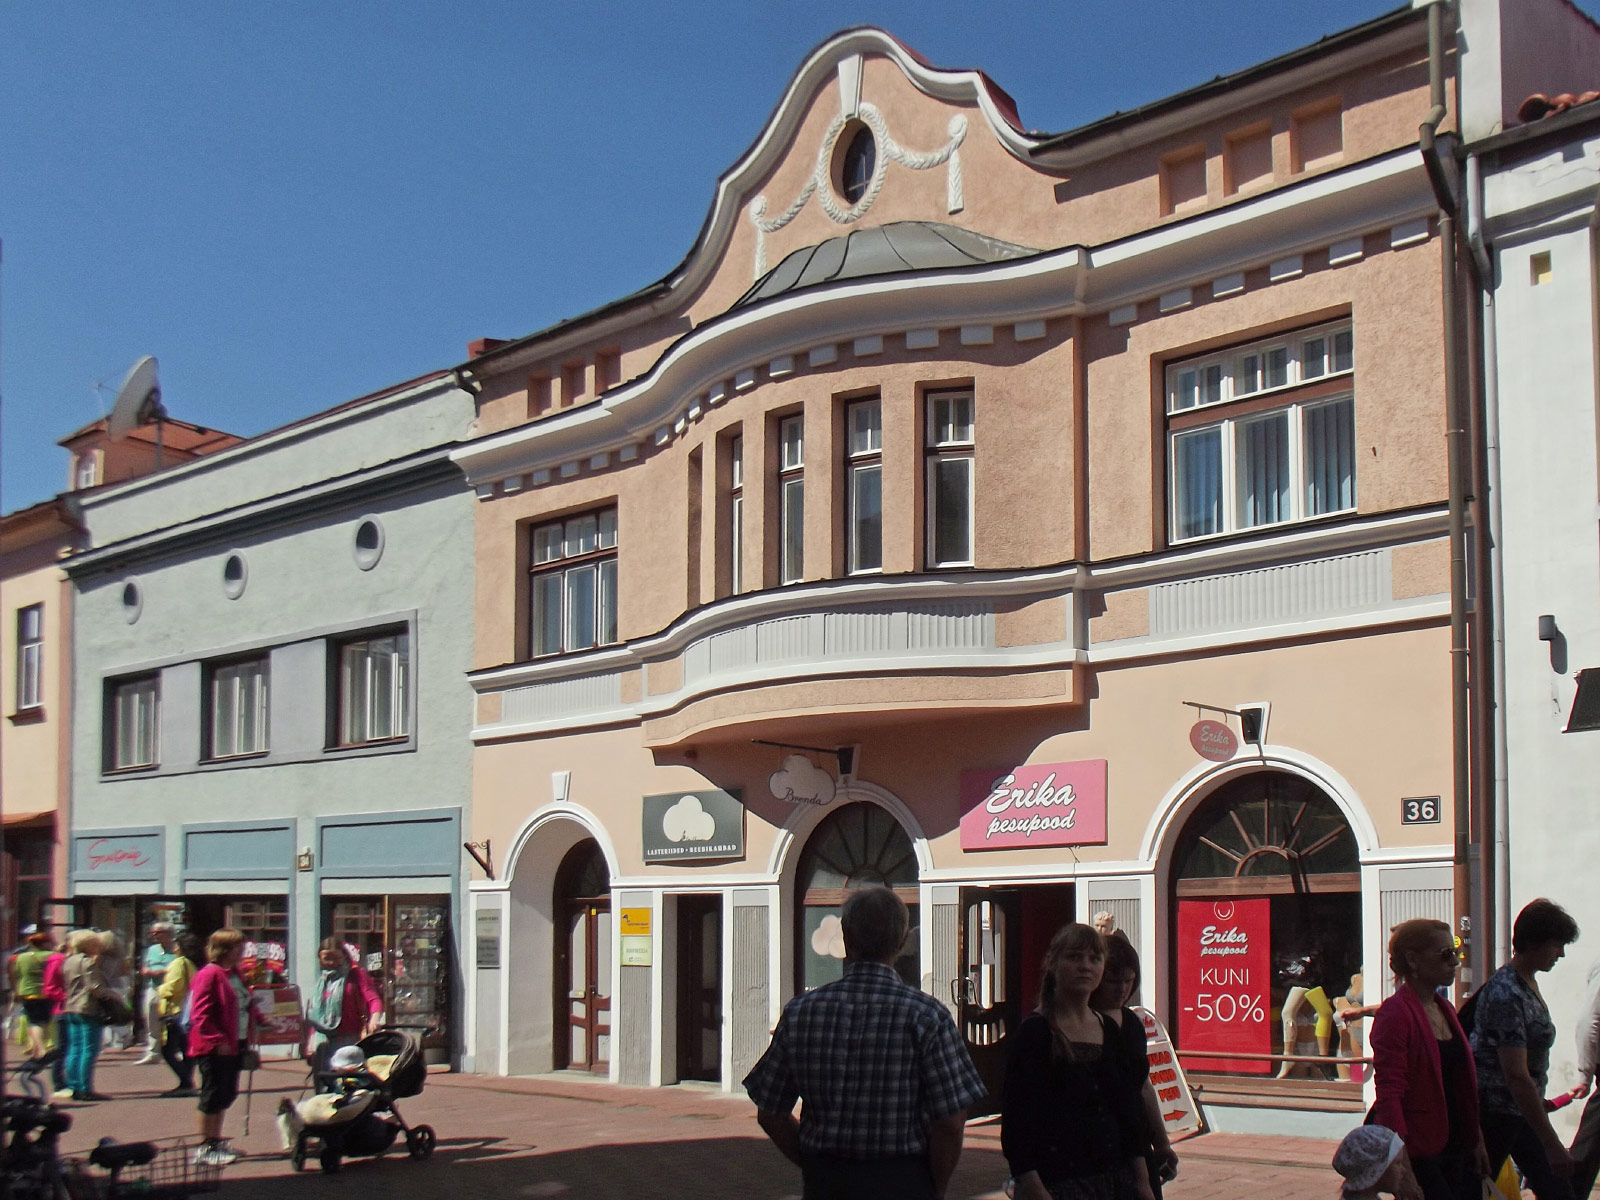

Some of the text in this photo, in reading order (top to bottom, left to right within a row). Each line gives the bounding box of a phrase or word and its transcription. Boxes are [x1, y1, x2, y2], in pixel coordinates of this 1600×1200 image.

[1201, 725, 1229, 745] Erika
[785, 786, 822, 805] Brenda
[986, 772, 1076, 814] Erika
[1407, 800, 1435, 820] 36
[986, 808, 1076, 840] pesupood
[1200, 925, 1248, 945] Erika
[1200, 944, 1248, 957] pesupood
[1200, 968, 1249, 985] KUNI
[1183, 993, 1264, 1022] -50%
